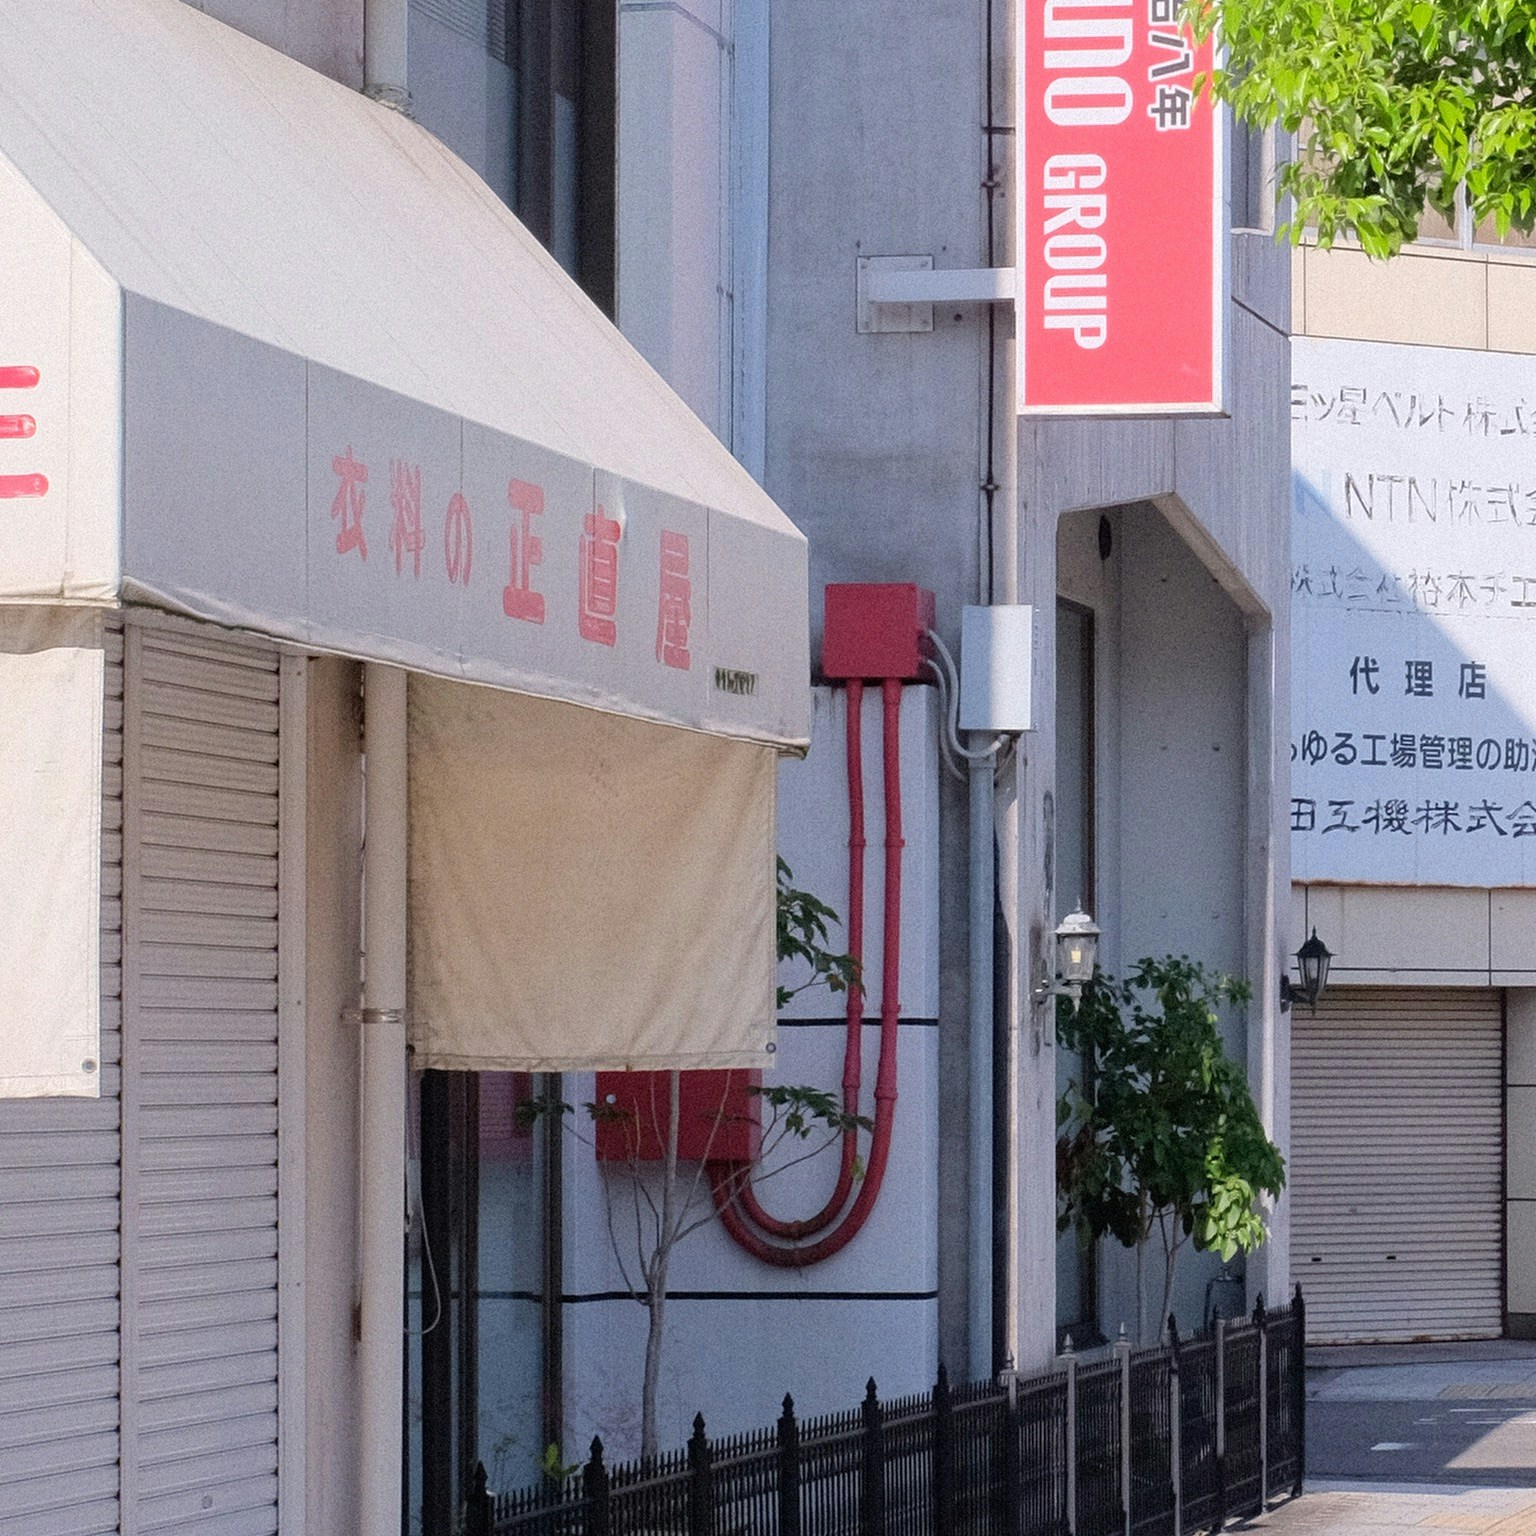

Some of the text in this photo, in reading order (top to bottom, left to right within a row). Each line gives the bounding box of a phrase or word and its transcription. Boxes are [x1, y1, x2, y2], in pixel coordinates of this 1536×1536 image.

[1043, 153, 1107, 349] GROUP
[1349, 655, 1488, 700] 代理店
